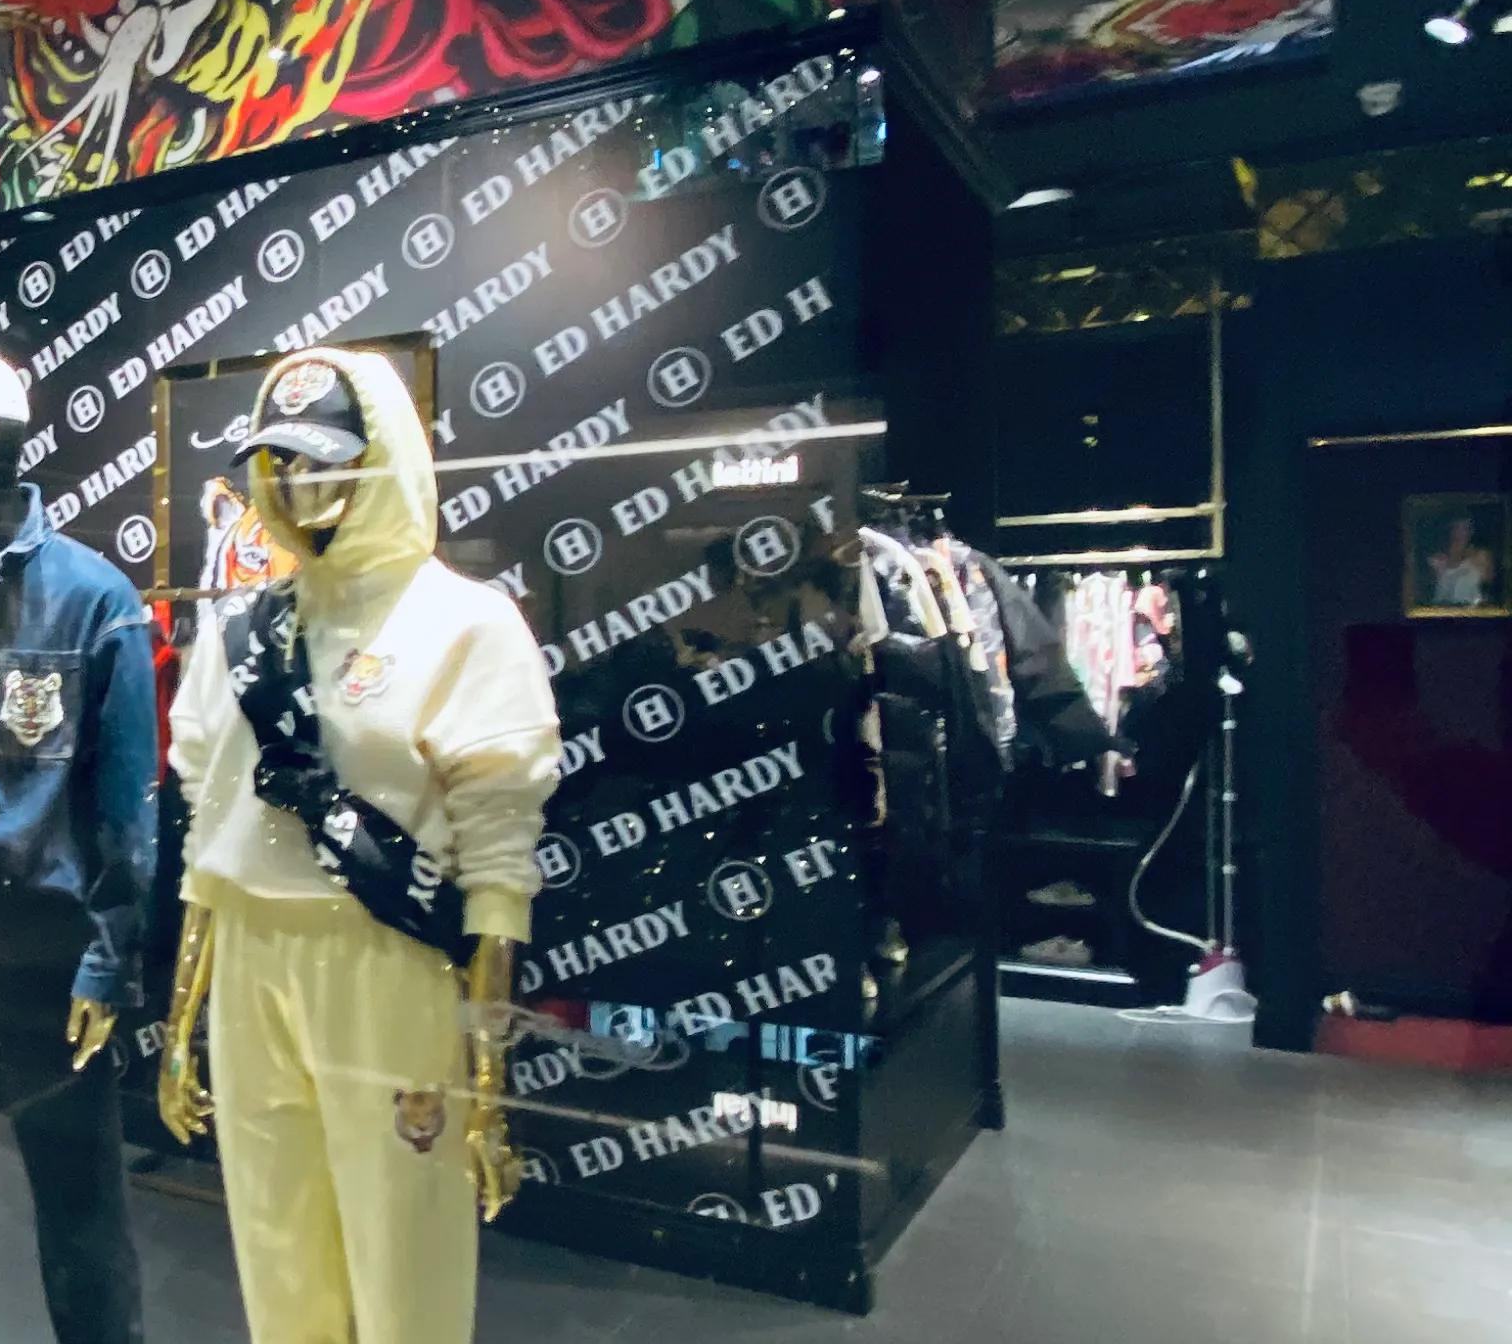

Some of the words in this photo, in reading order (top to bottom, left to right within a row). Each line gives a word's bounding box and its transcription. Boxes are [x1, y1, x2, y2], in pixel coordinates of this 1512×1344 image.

[461, 175, 513, 225] ED
[514, 94, 656, 186] HARD
[637, 146, 696, 200] ED
[701, 55, 835, 157] HARD
[59, 230, 96, 272] ED
[175, 216, 216, 261] ED
[309, 194, 356, 242] ED
[32, 292, 122, 380] HARDY
[108, 357, 147, 399] ED
[146, 276, 248, 370] HARDY
[273, 262, 389, 352] HARDY
[421, 242, 553, 348] HARDY
[535, 326, 589, 377] ED
[591, 224, 740, 340] HARDY
[720, 308, 784, 363] ED
[45, 492, 81, 531] ED
[79, 431, 156, 507] HARD
[439, 485, 492, 533] ED
[492, 398, 633, 502] HARDY
[611, 487, 670, 536] ED
[671, 392, 831, 504] HDY
[567, 564, 716, 661] HARDY
[693, 657, 756, 706] ED
[589, 812, 647, 857] ED
[649, 741, 805, 833] HARDY
[547, 900, 691, 982] HARDY
[569, 1136, 624, 1178] ED
[760, 1183, 821, 1228] ED
